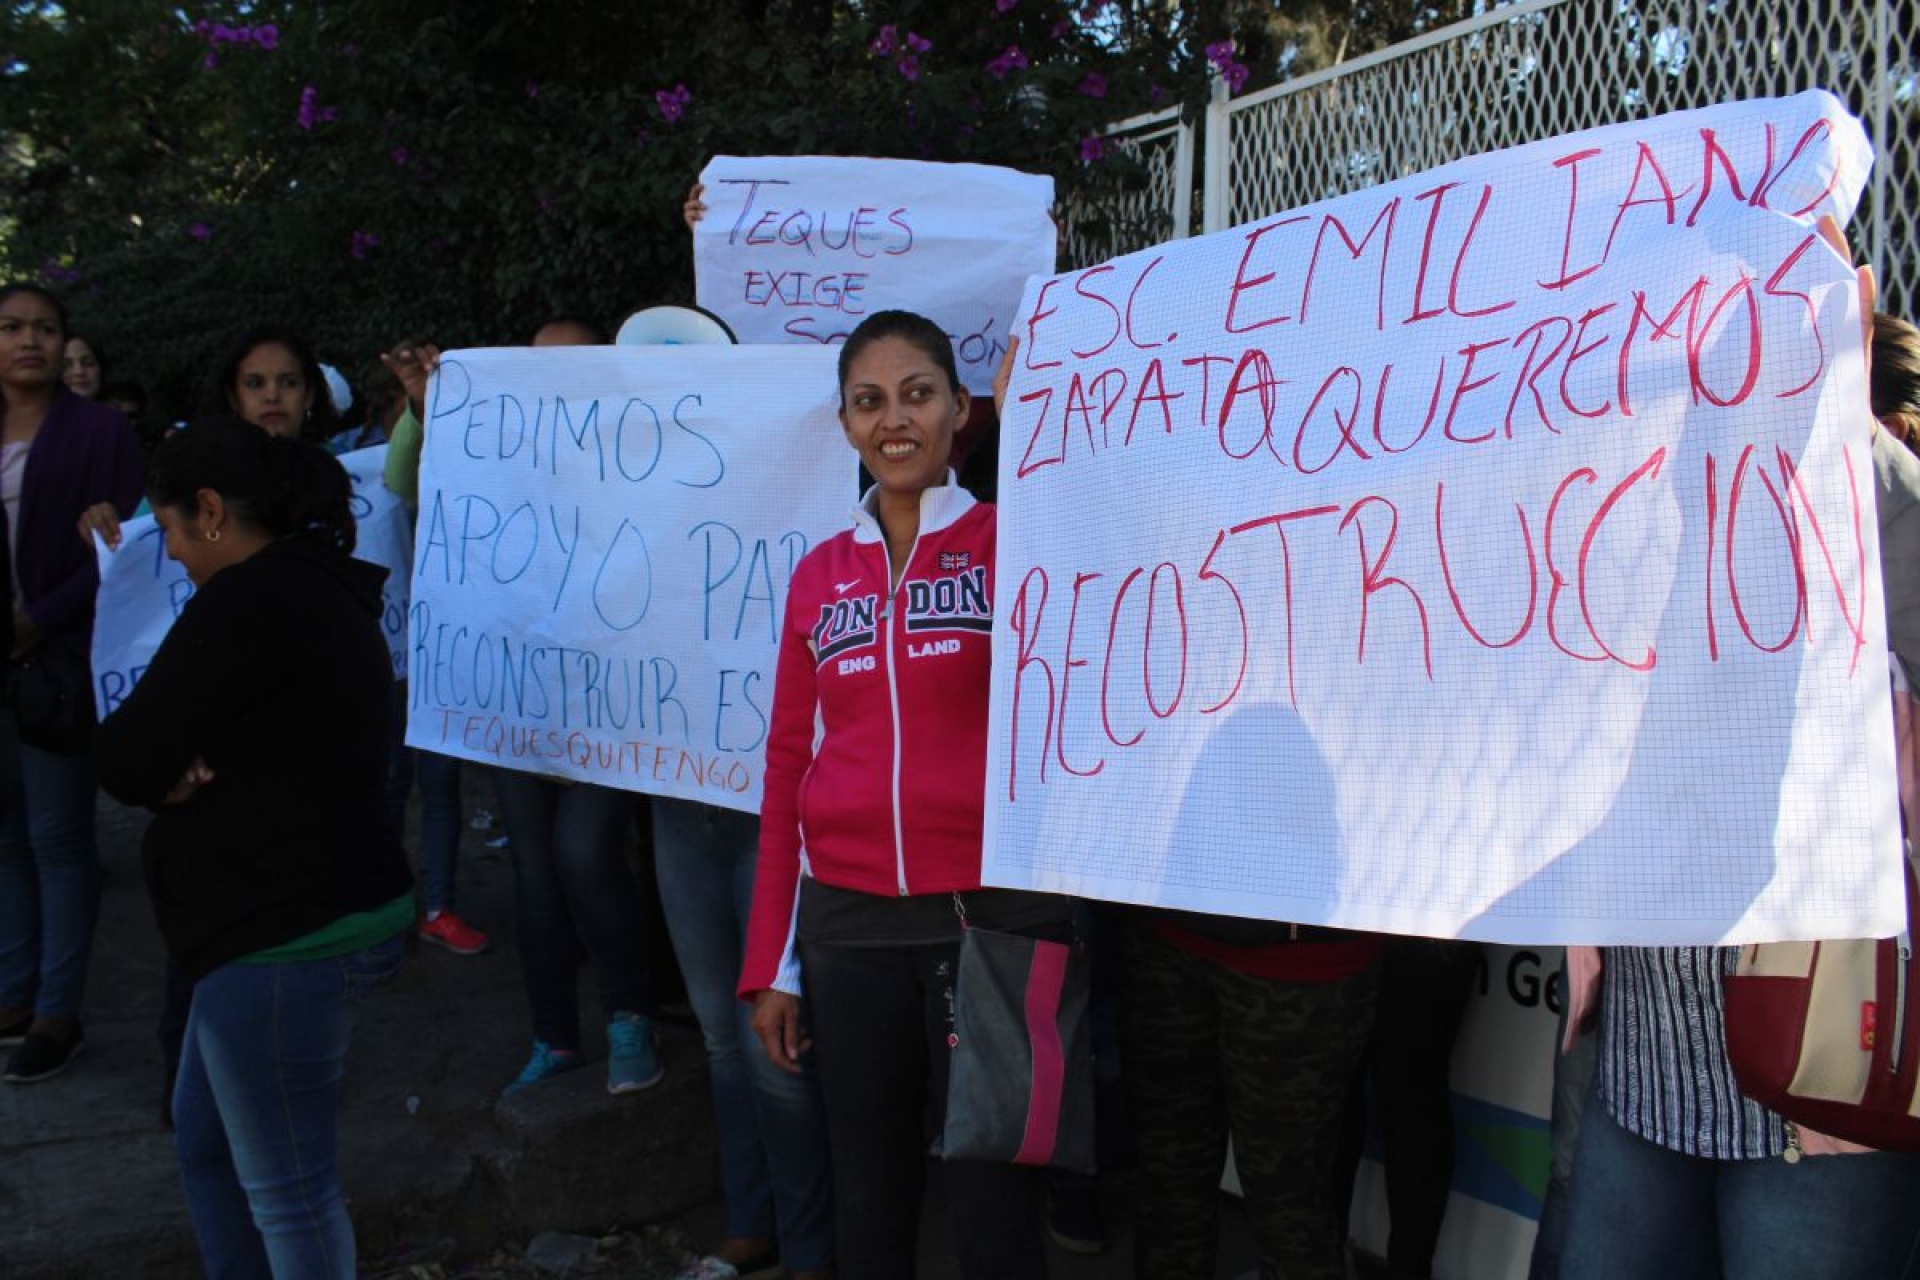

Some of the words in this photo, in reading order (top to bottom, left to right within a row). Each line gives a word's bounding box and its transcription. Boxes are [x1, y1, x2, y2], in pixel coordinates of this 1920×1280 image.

[719, 179, 914, 258] TEQUES
[743, 271, 870, 315] EXIGE
[1025, 255, 1179, 371] ESC.
[430, 359, 725, 489] PEDIMOS
[419, 489, 652, 631] APOYO
[906, 566, 990, 614] DON
[410, 601, 690, 745] RECONSTRUIR
[838, 656, 876, 676] ENG
[907, 639, 961, 658] LAND
[434, 708, 750, 794] TEQUESQUITENGO
